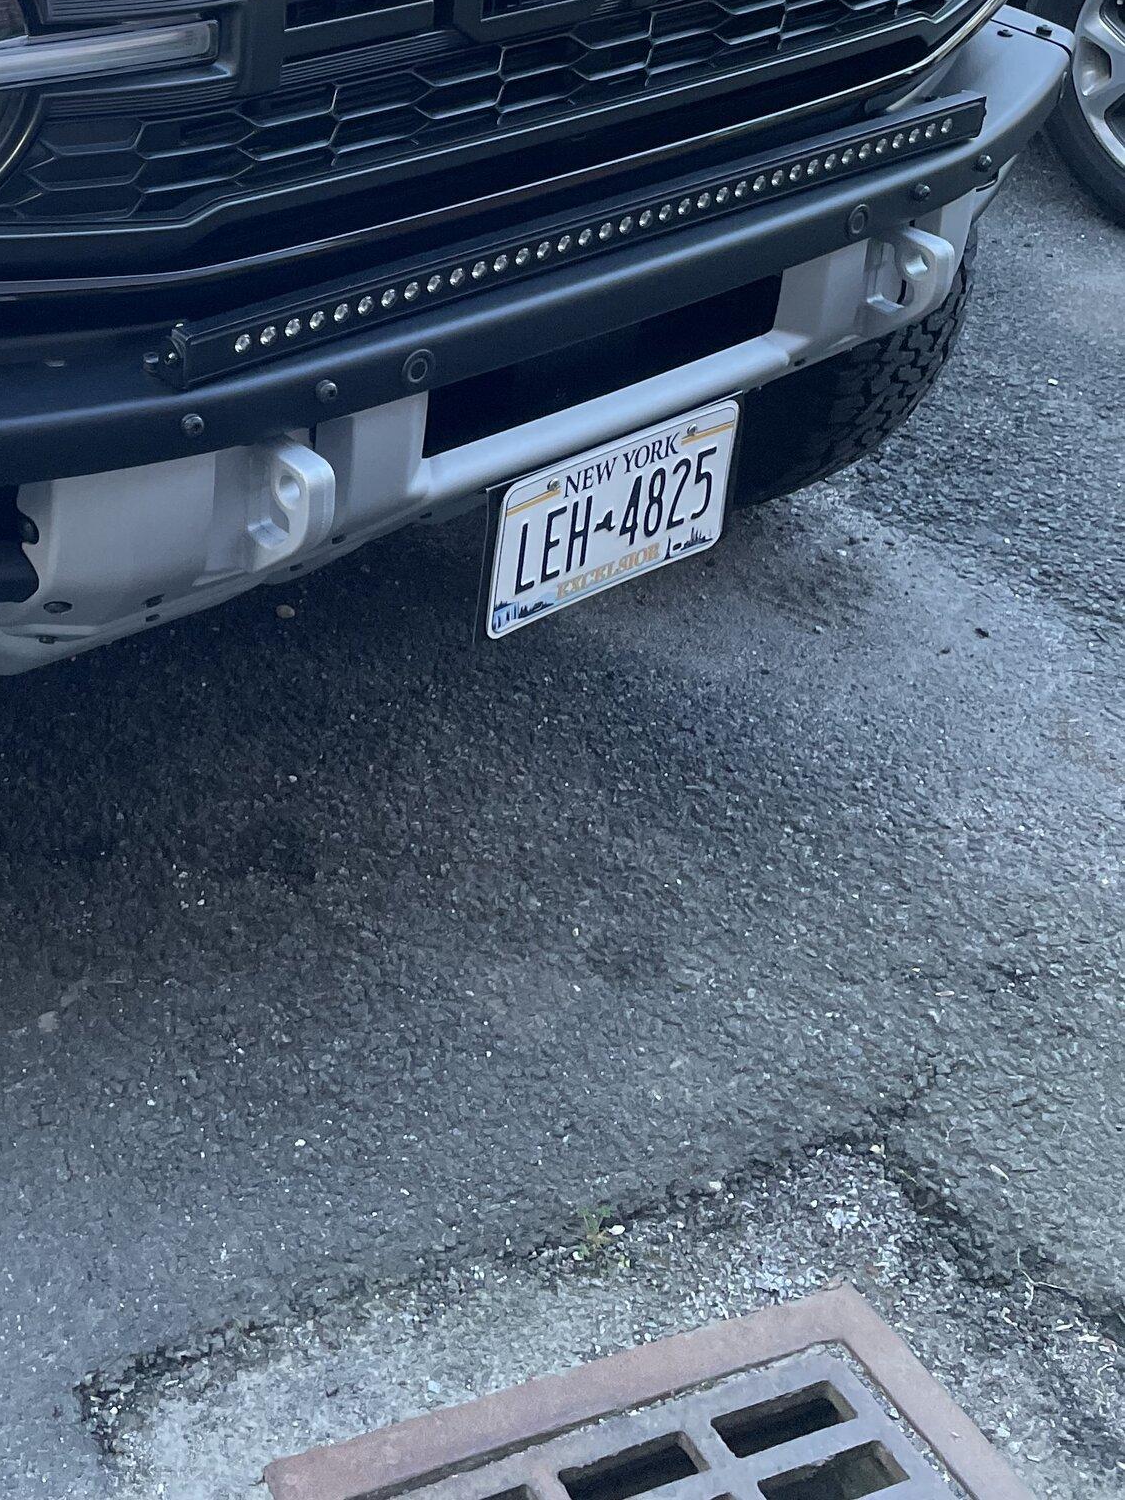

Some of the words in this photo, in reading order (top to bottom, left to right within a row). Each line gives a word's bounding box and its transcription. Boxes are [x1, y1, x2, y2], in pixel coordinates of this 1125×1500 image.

[564, 456, 618, 498] NEW
[623, 432, 679, 475] YORK
[515, 495, 593, 596] LEH
[619, 446, 718, 546] 4825
[556, 542, 661, 600] EXCELSIOR
